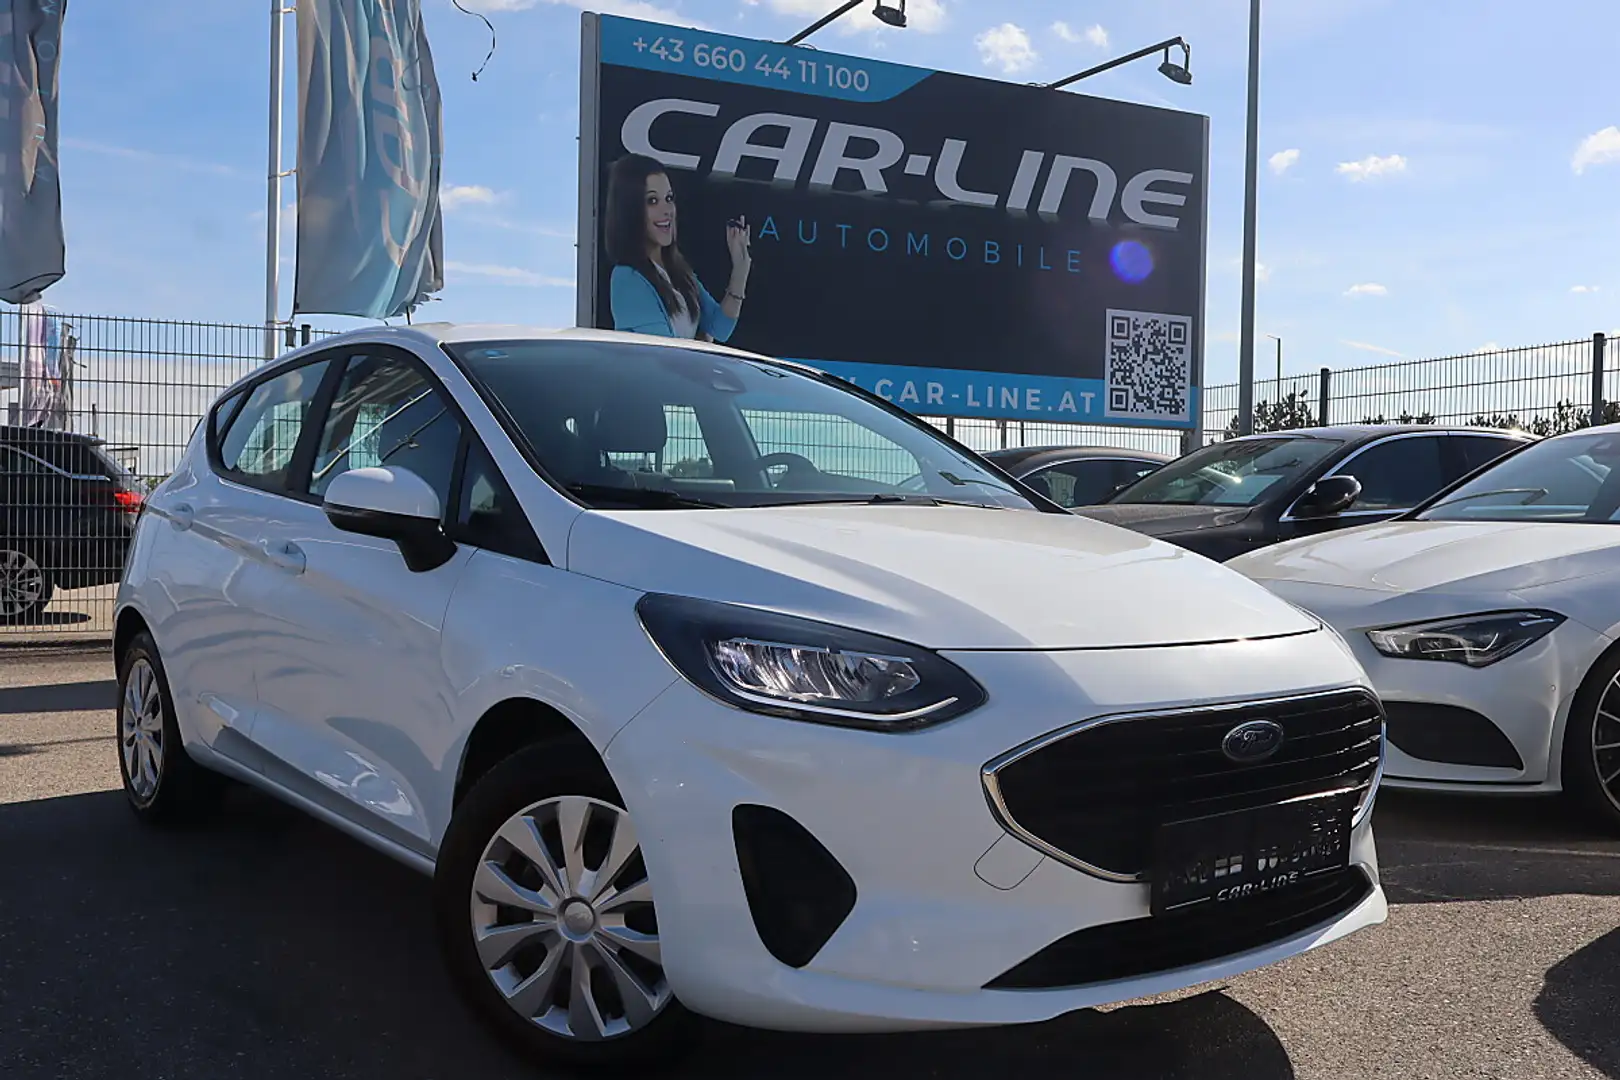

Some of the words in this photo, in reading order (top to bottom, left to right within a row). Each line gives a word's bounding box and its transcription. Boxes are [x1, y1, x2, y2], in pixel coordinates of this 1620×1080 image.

[632, 36, 685, 63] +43
[693, 43, 747, 73] 660
[754, 53, 791, 80] 44
[798, 59, 817, 85] 11
[825, 64, 870, 92] 100
[620, 98, 1195, 229] CAR-LINE
[758, 215, 1083, 274] AUTOMOBILE
[839, 376, 1097, 414] CAR-LINE.AT
